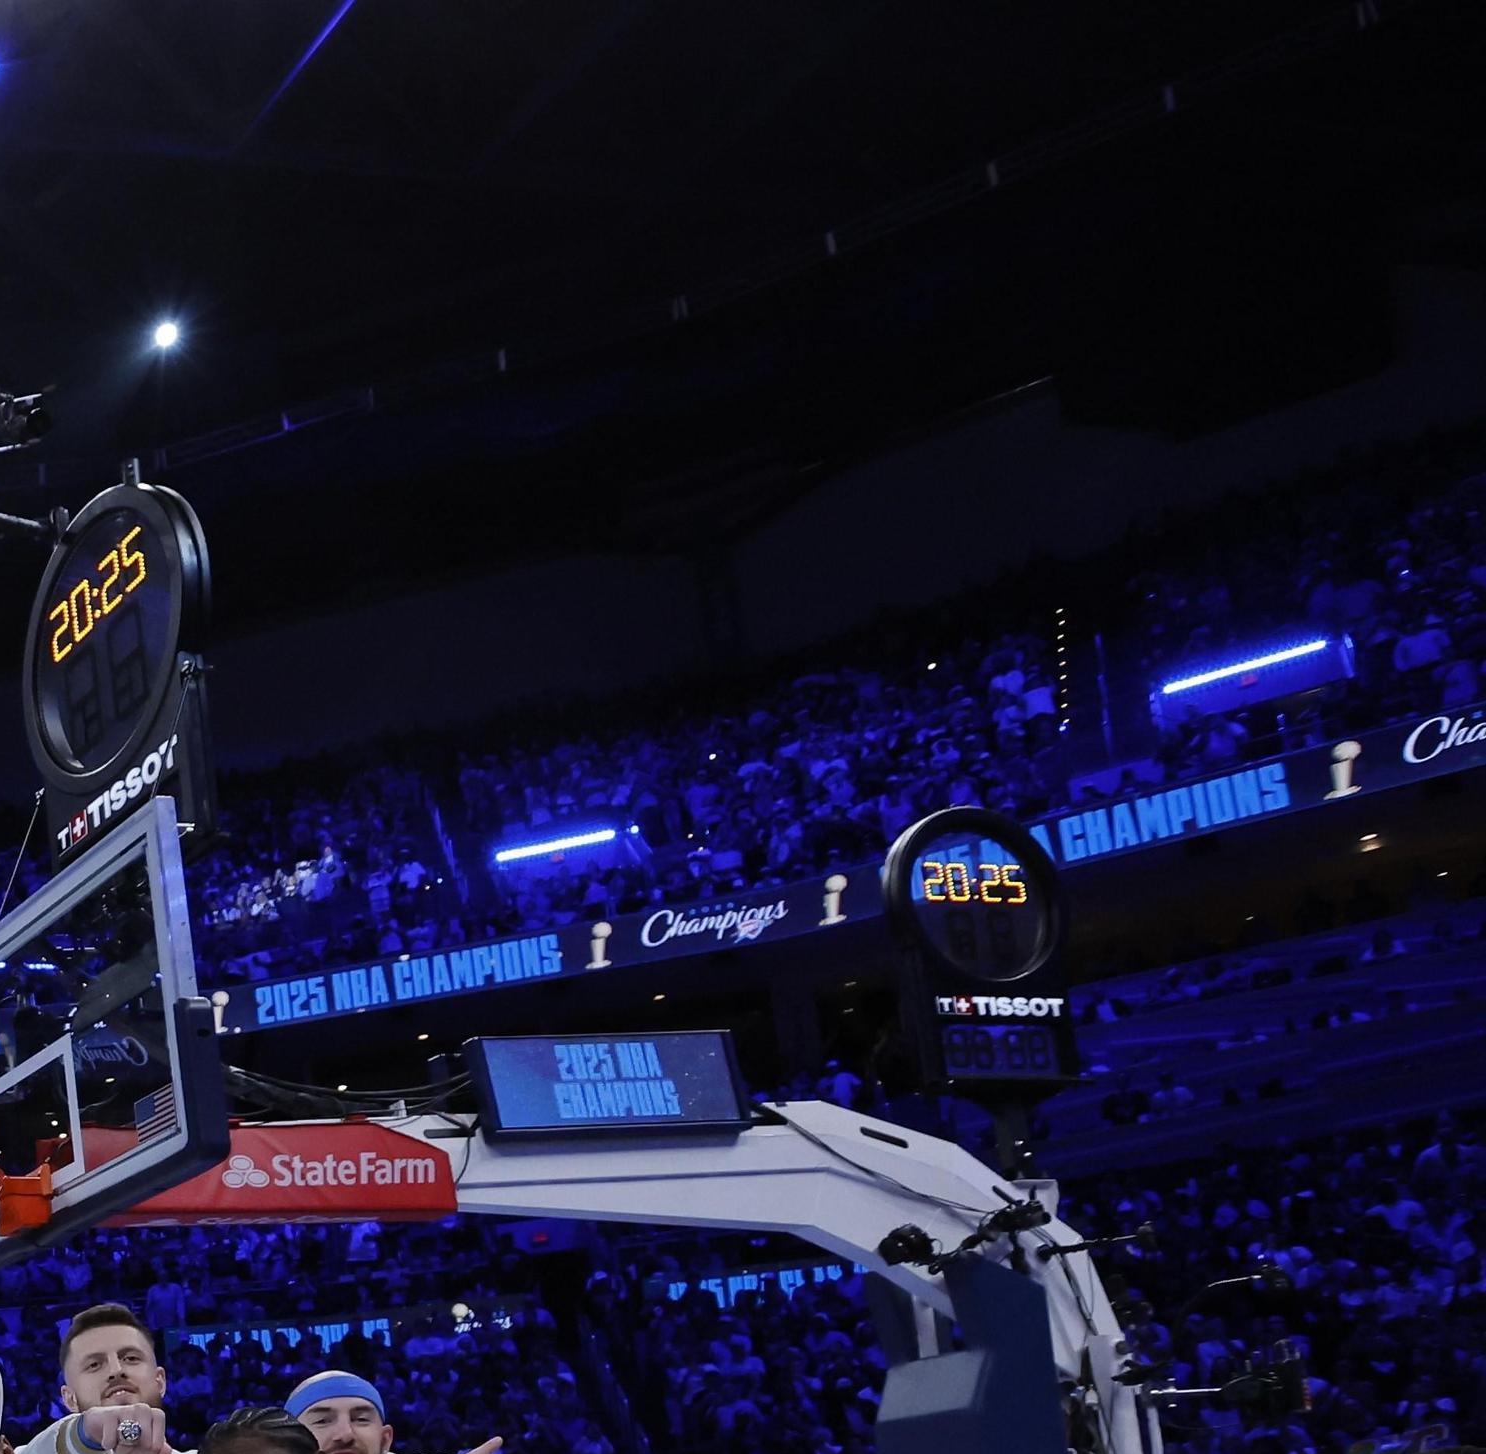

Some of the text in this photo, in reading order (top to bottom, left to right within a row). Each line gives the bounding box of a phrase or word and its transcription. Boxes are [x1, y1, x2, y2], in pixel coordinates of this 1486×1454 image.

[49, 526, 147, 662] 20:25
[87, 734, 178, 830] TISSOT
[1059, 764, 1291, 862] CHAMPIONS
[923, 862, 1027, 903] 20:25
[641, 900, 789, 947] Champions
[256, 934, 562, 1023] 2025 NBA CHAMPIONS
[972, 996, 1064, 1017] TISSOT
[554, 1042, 662, 1080] 2025 NBA
[554, 1080, 681, 1119] CHAMPIONS
